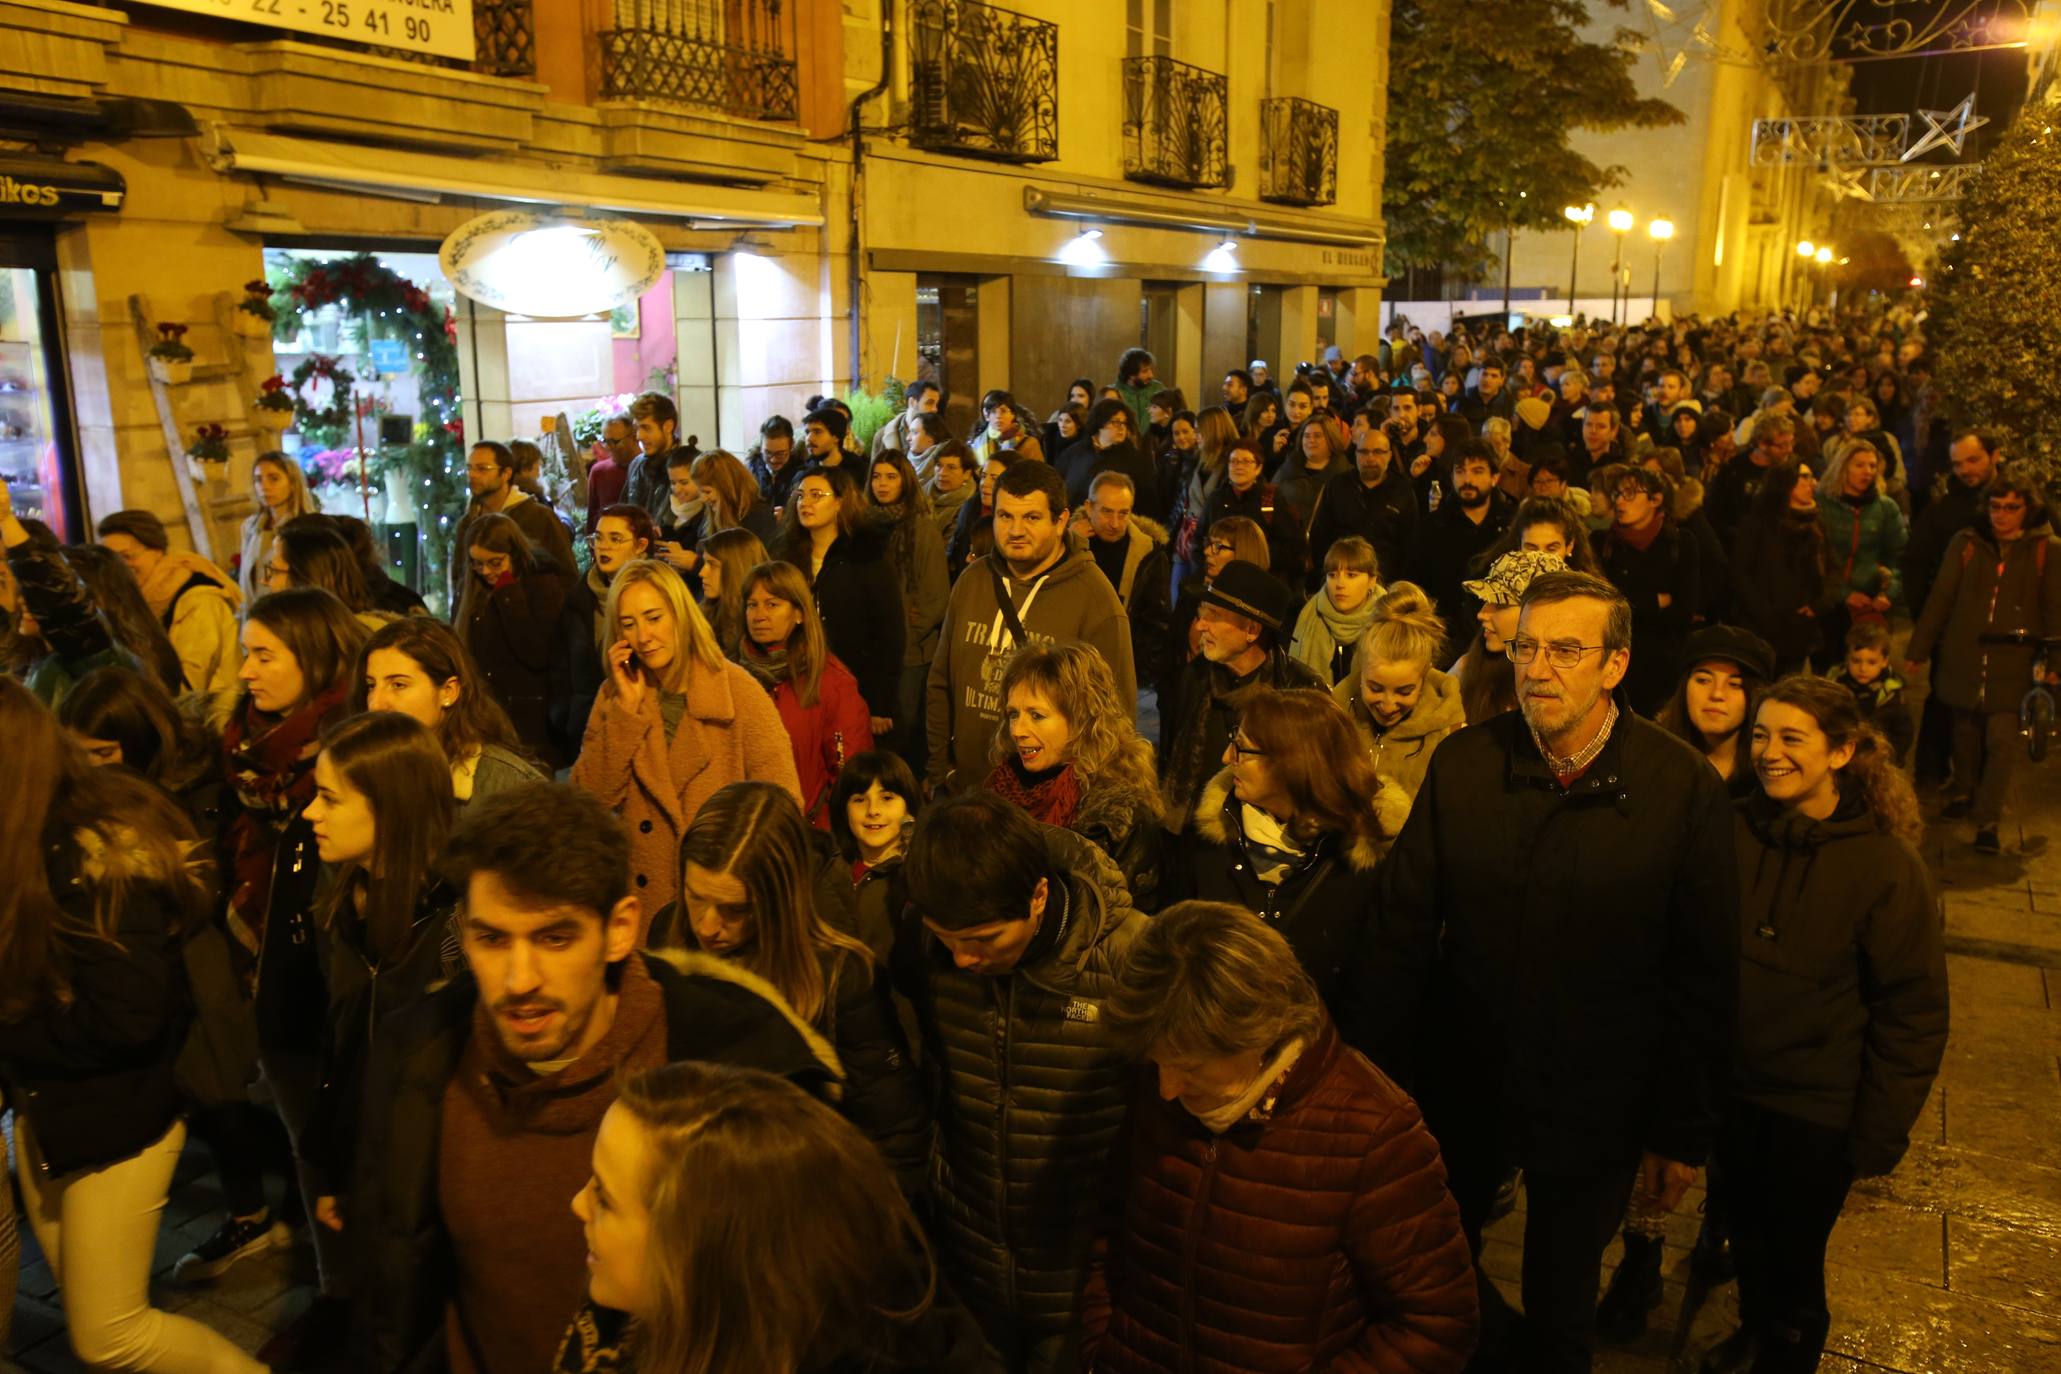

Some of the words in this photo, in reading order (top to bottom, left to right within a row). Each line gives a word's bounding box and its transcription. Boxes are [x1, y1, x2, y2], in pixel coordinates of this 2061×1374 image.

[320, 1, 350, 28] 25
[364, 8, 389, 35] 41
[405, 16, 430, 43] 90
[965, 686, 1001, 713] ULTIM
[1072, 1000, 1088, 1010] THE
